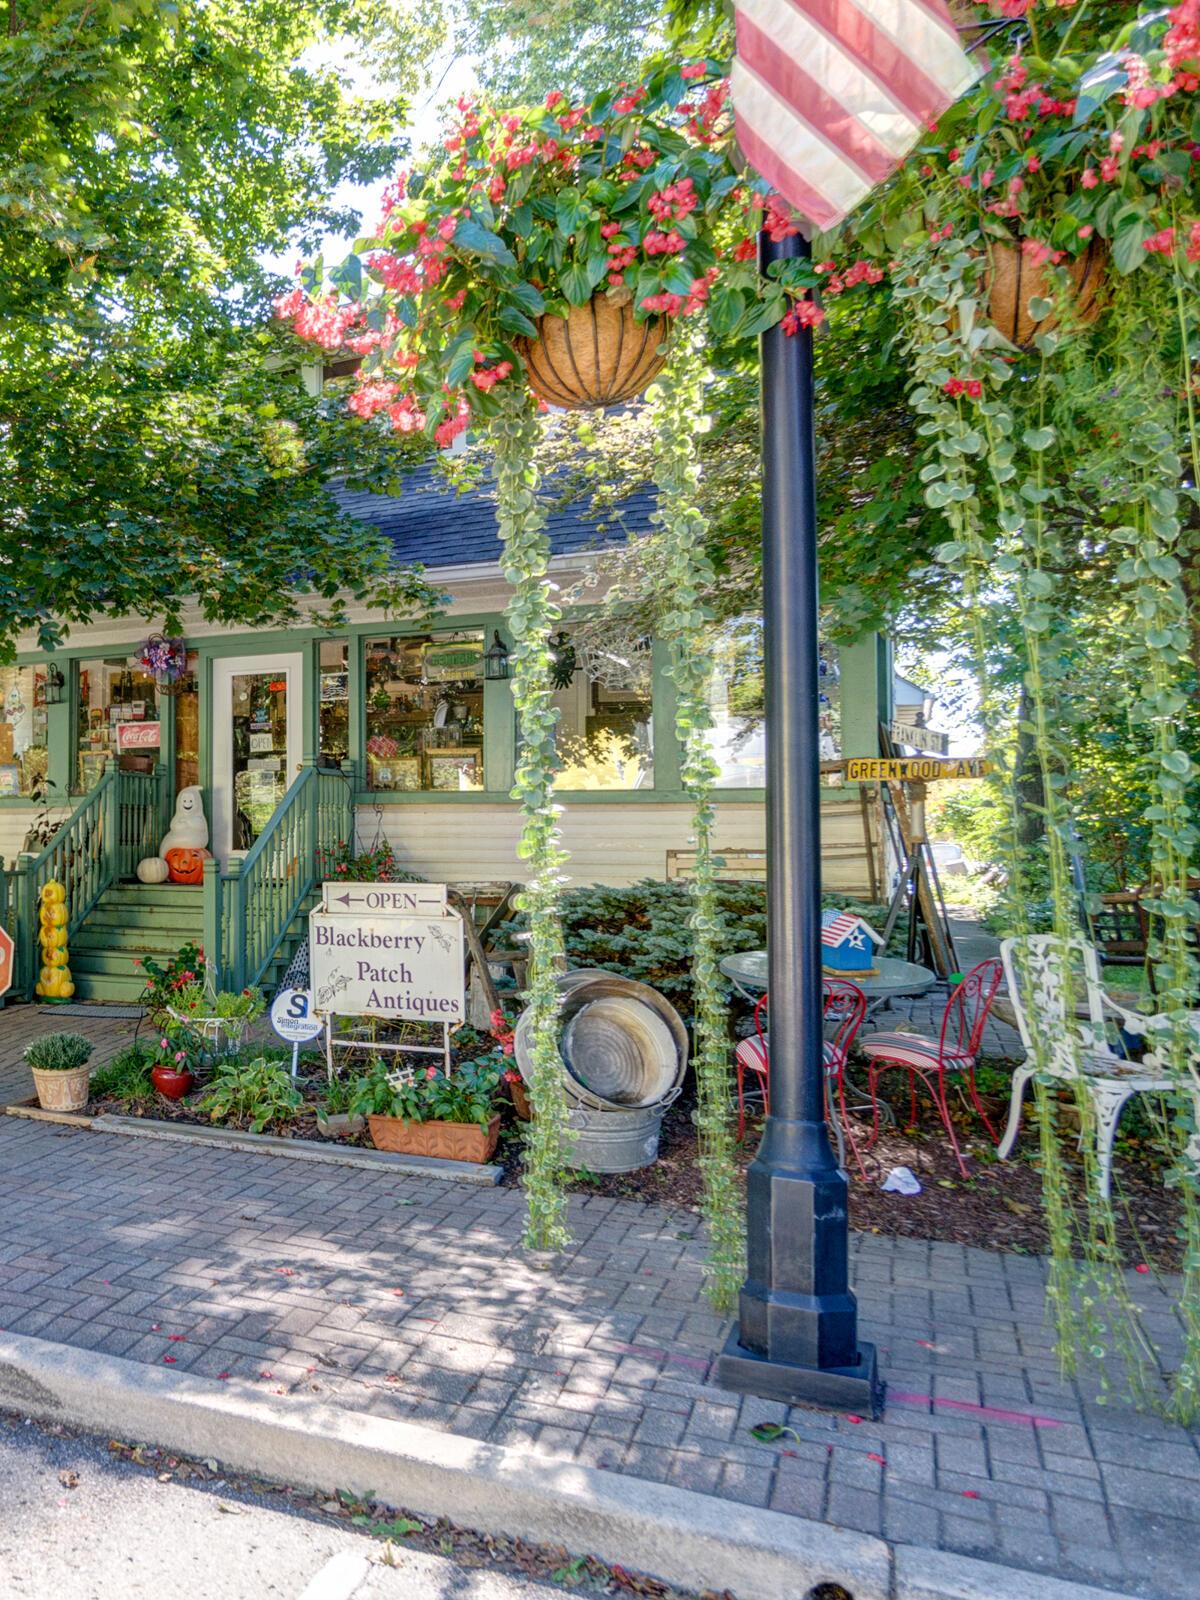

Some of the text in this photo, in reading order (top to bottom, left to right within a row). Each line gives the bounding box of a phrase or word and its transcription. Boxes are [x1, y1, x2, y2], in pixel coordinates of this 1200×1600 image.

[251, 737, 271, 749] OPEN
[850, 759, 985, 779] GREENWOOD AVE
[366, 892, 417, 909] OPEN
[315, 926, 426, 954] Blackberry
[357, 961, 413, 984] Patch
[366, 988, 460, 1015] Antiques
[276, 1016, 299, 1025] Simon
